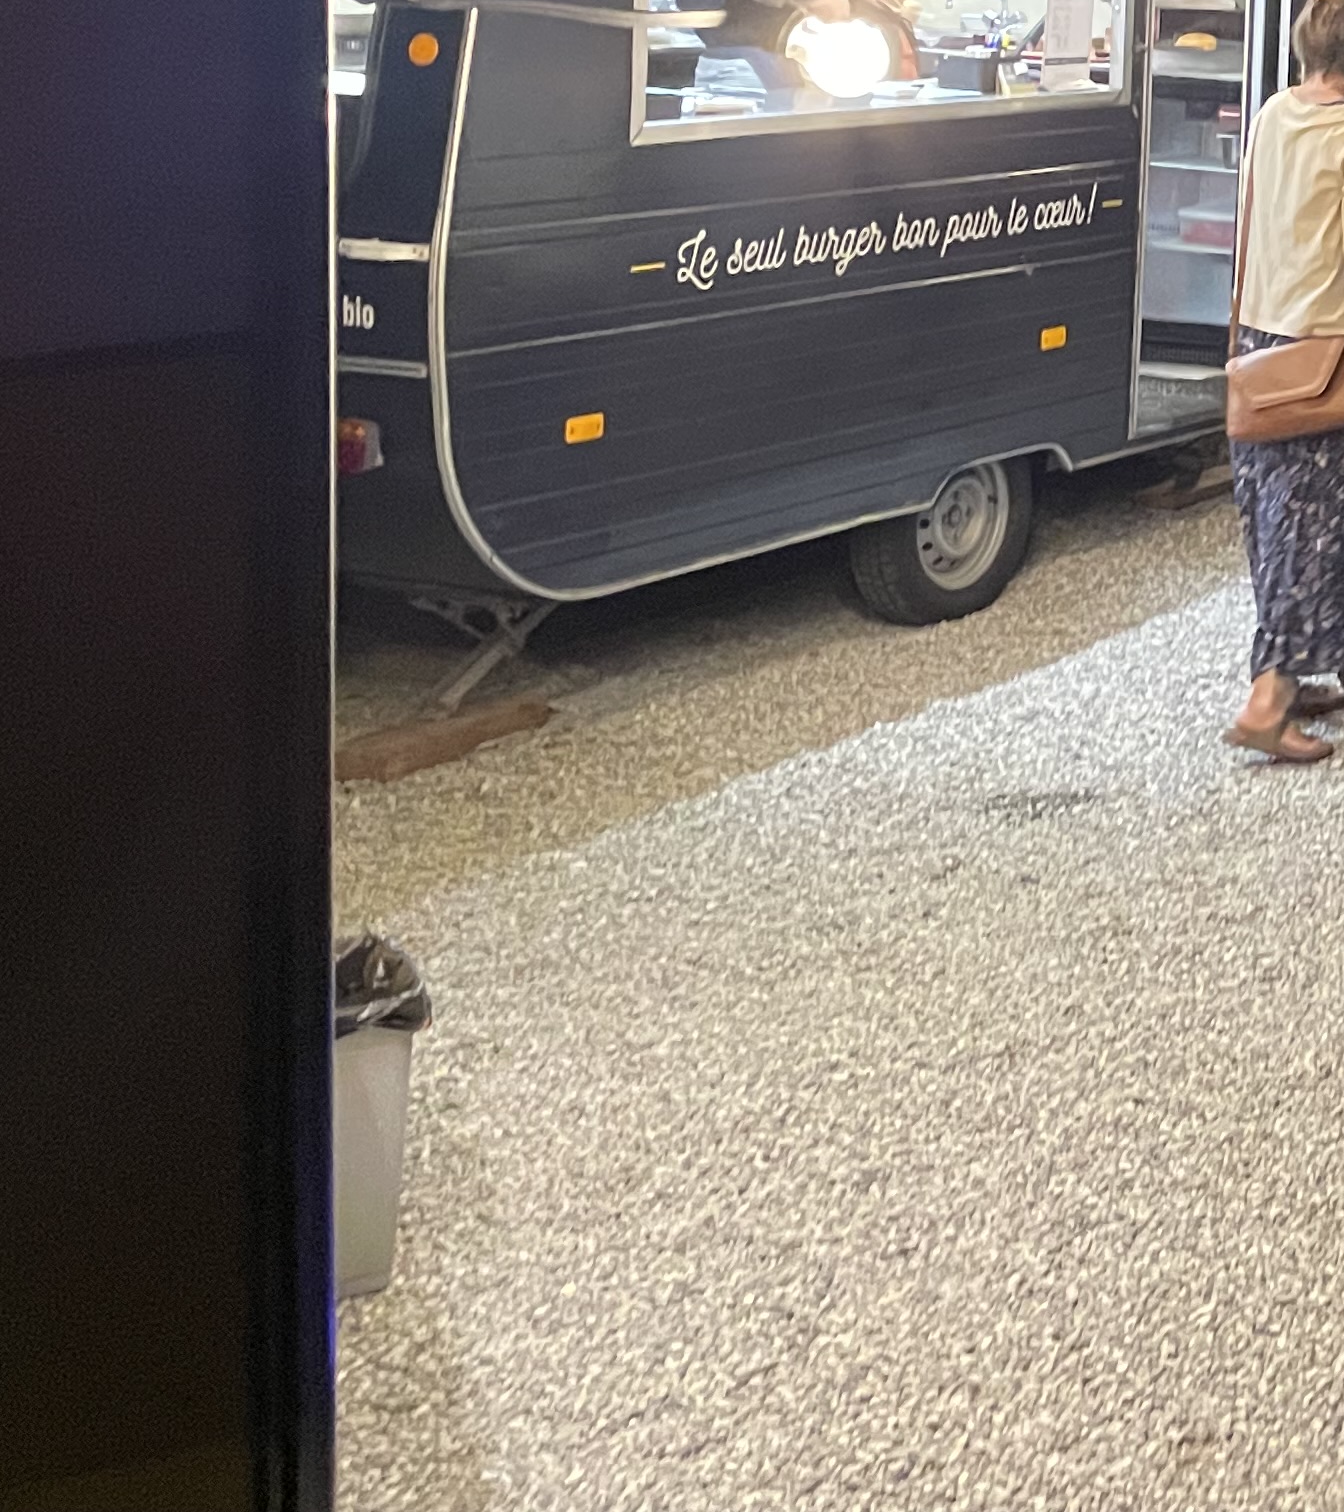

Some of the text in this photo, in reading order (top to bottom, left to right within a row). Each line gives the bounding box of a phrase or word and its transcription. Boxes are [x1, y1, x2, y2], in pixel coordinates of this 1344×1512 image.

[677, 229, 719, 290] Le
[727, 227, 786, 275] seul
[793, 222, 886, 276] burger
[892, 211, 940, 252] bon
[940, 205, 1002, 258] pour
[1007, 196, 1029, 236] le
